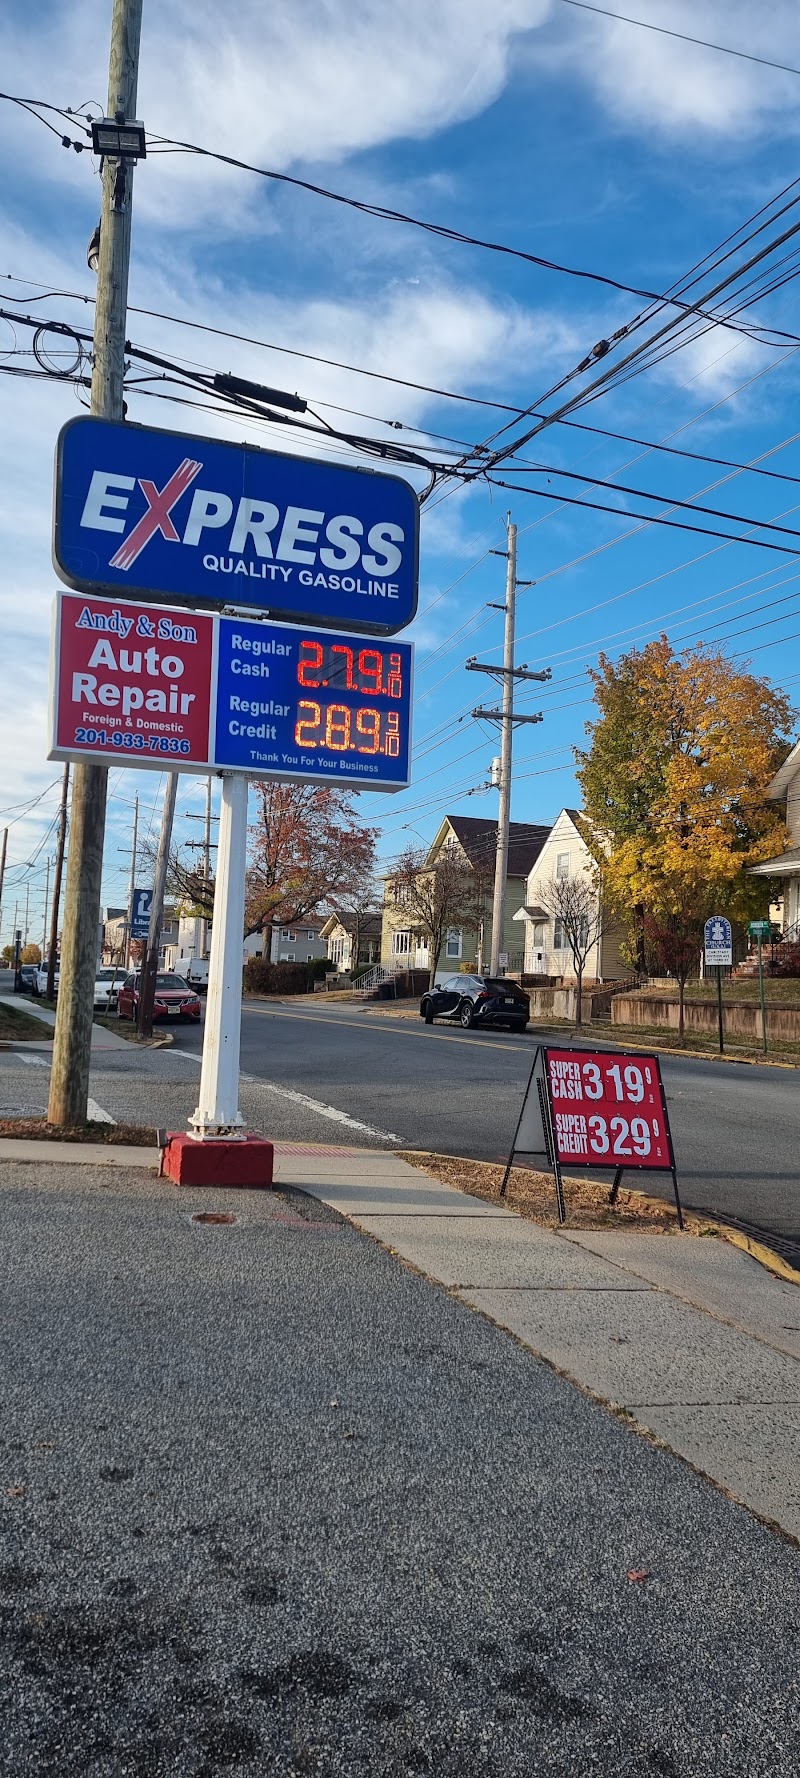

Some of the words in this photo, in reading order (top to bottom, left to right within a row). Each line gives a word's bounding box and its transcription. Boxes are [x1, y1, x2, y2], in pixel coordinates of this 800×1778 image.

[80, 458, 405, 577] EXPRESS
[203, 554, 292, 582] QUALITY
[299, 569, 399, 599] GASOLINE
[75, 606, 134, 638] Andy
[136, 615, 155, 637] &
[158, 618, 197, 644] Son
[87, 638, 184, 678] Auto
[231, 635, 292, 659] Regular
[230, 659, 270, 678] Cash
[72, 672, 196, 715] Repair
[229, 695, 290, 717] Regular
[82, 712, 122, 727] Foreign
[125, 718, 133, 727] &
[136, 718, 184, 732] Domestic
[228, 720, 277, 740] Credit
[75, 728, 190, 754] 201-933-7836
[250, 750, 279, 763] Thank
[281, 753, 298, 765] You
[300, 756, 315, 766] For
[317, 757, 337, 769] Your
[339, 760, 379, 773] Business
[550, 1060, 580, 1080] SUPER
[582, 1062, 645, 1102] 319
[551, 1078, 583, 1100] CASH
[555, 1113, 587, 1134] SUPER
[588, 1115, 652, 1156] 329
[557, 1131, 588, 1154] CREDIT
